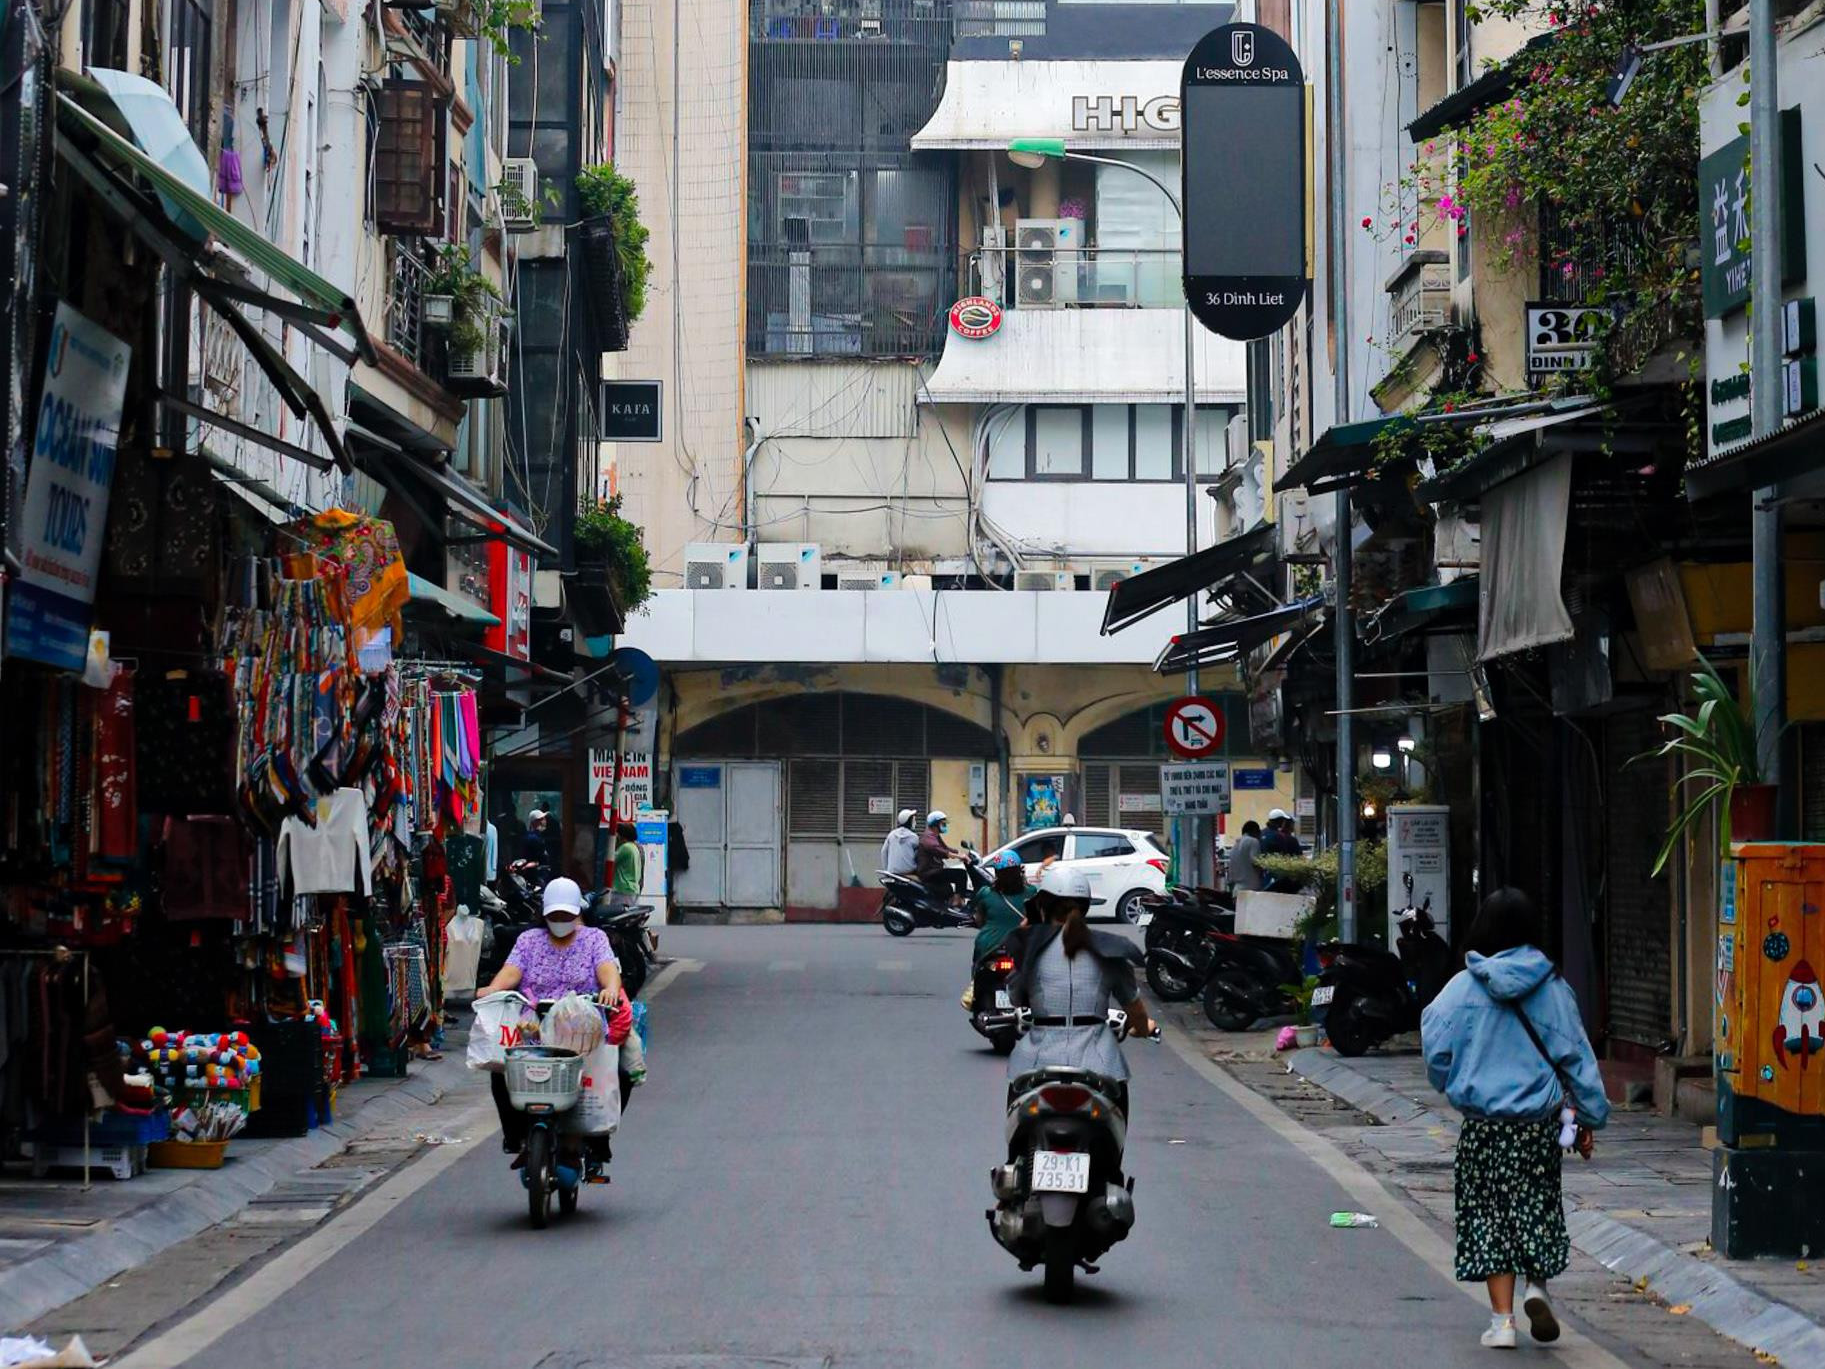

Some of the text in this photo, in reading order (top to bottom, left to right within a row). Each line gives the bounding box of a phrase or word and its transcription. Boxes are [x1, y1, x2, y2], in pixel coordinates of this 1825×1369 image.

[1197, 67, 1289, 82] L'essence Spa
[1205, 292, 1284, 305] 36 Dinh Liet
[593, 765, 649, 778] VIENAM
